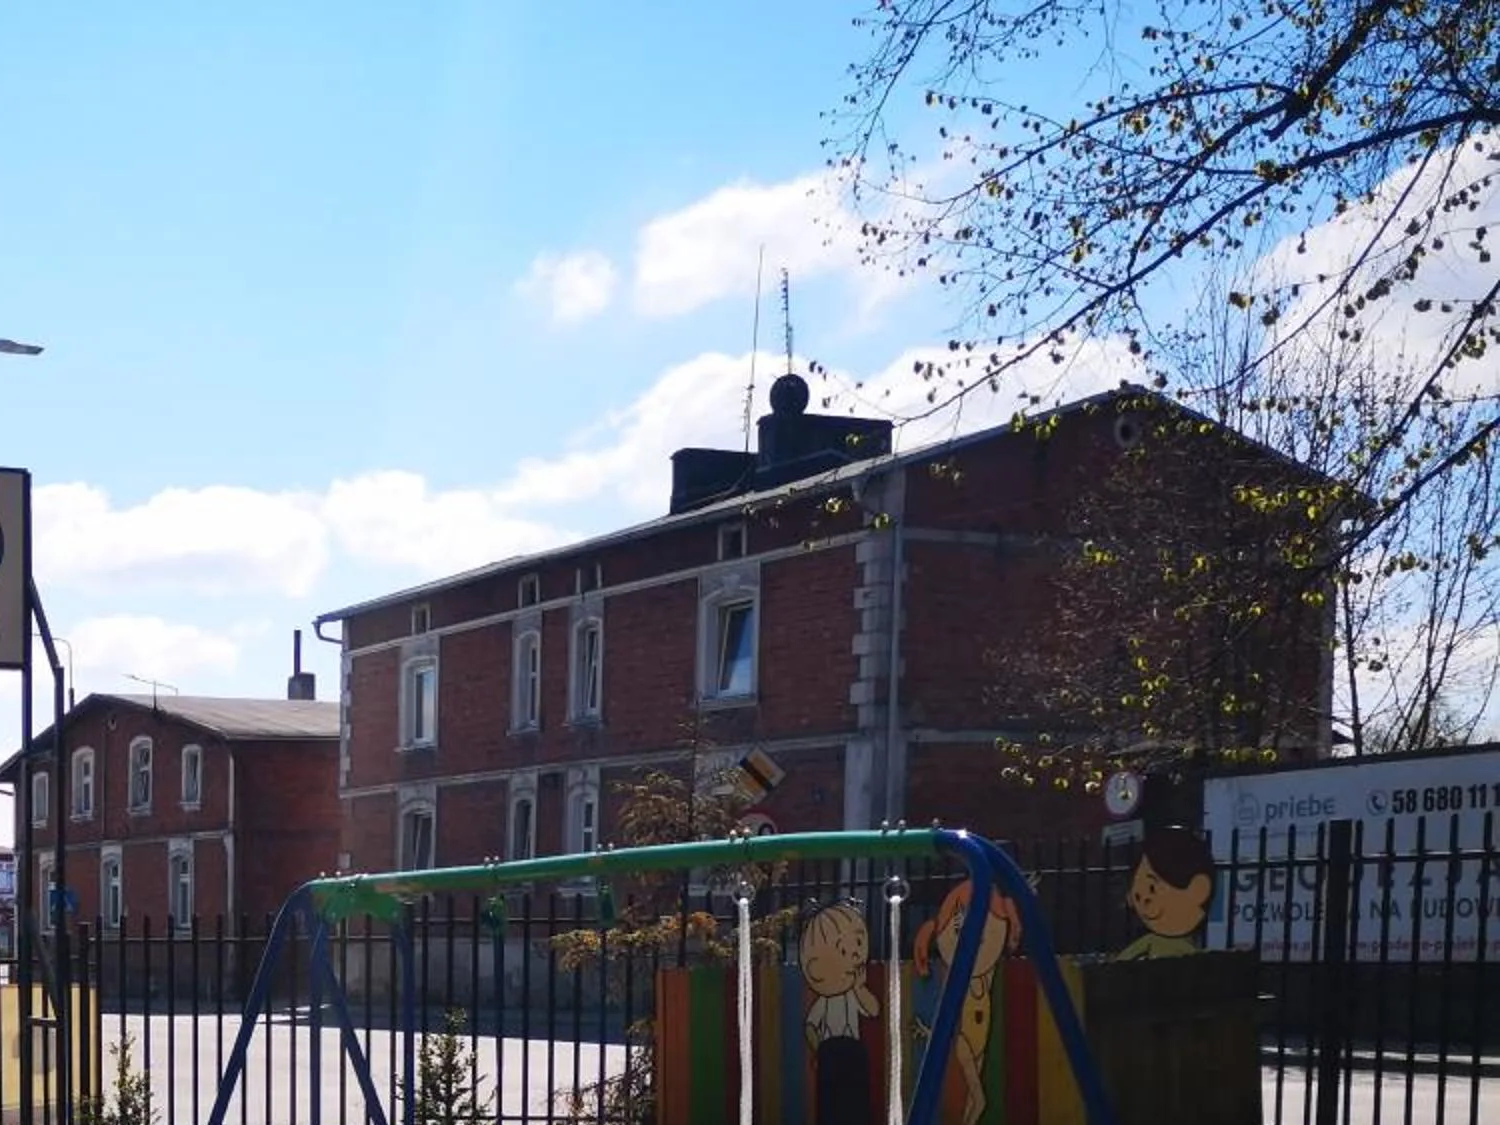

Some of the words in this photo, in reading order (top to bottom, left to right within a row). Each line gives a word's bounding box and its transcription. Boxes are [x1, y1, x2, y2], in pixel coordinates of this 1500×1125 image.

[1265, 793, 1336, 825] priebe
[1392, 788, 1418, 815] 58
[1423, 785, 1463, 812] 680
[1467, 783, 1487, 809] 11
[1369, 899, 1402, 919] NA
